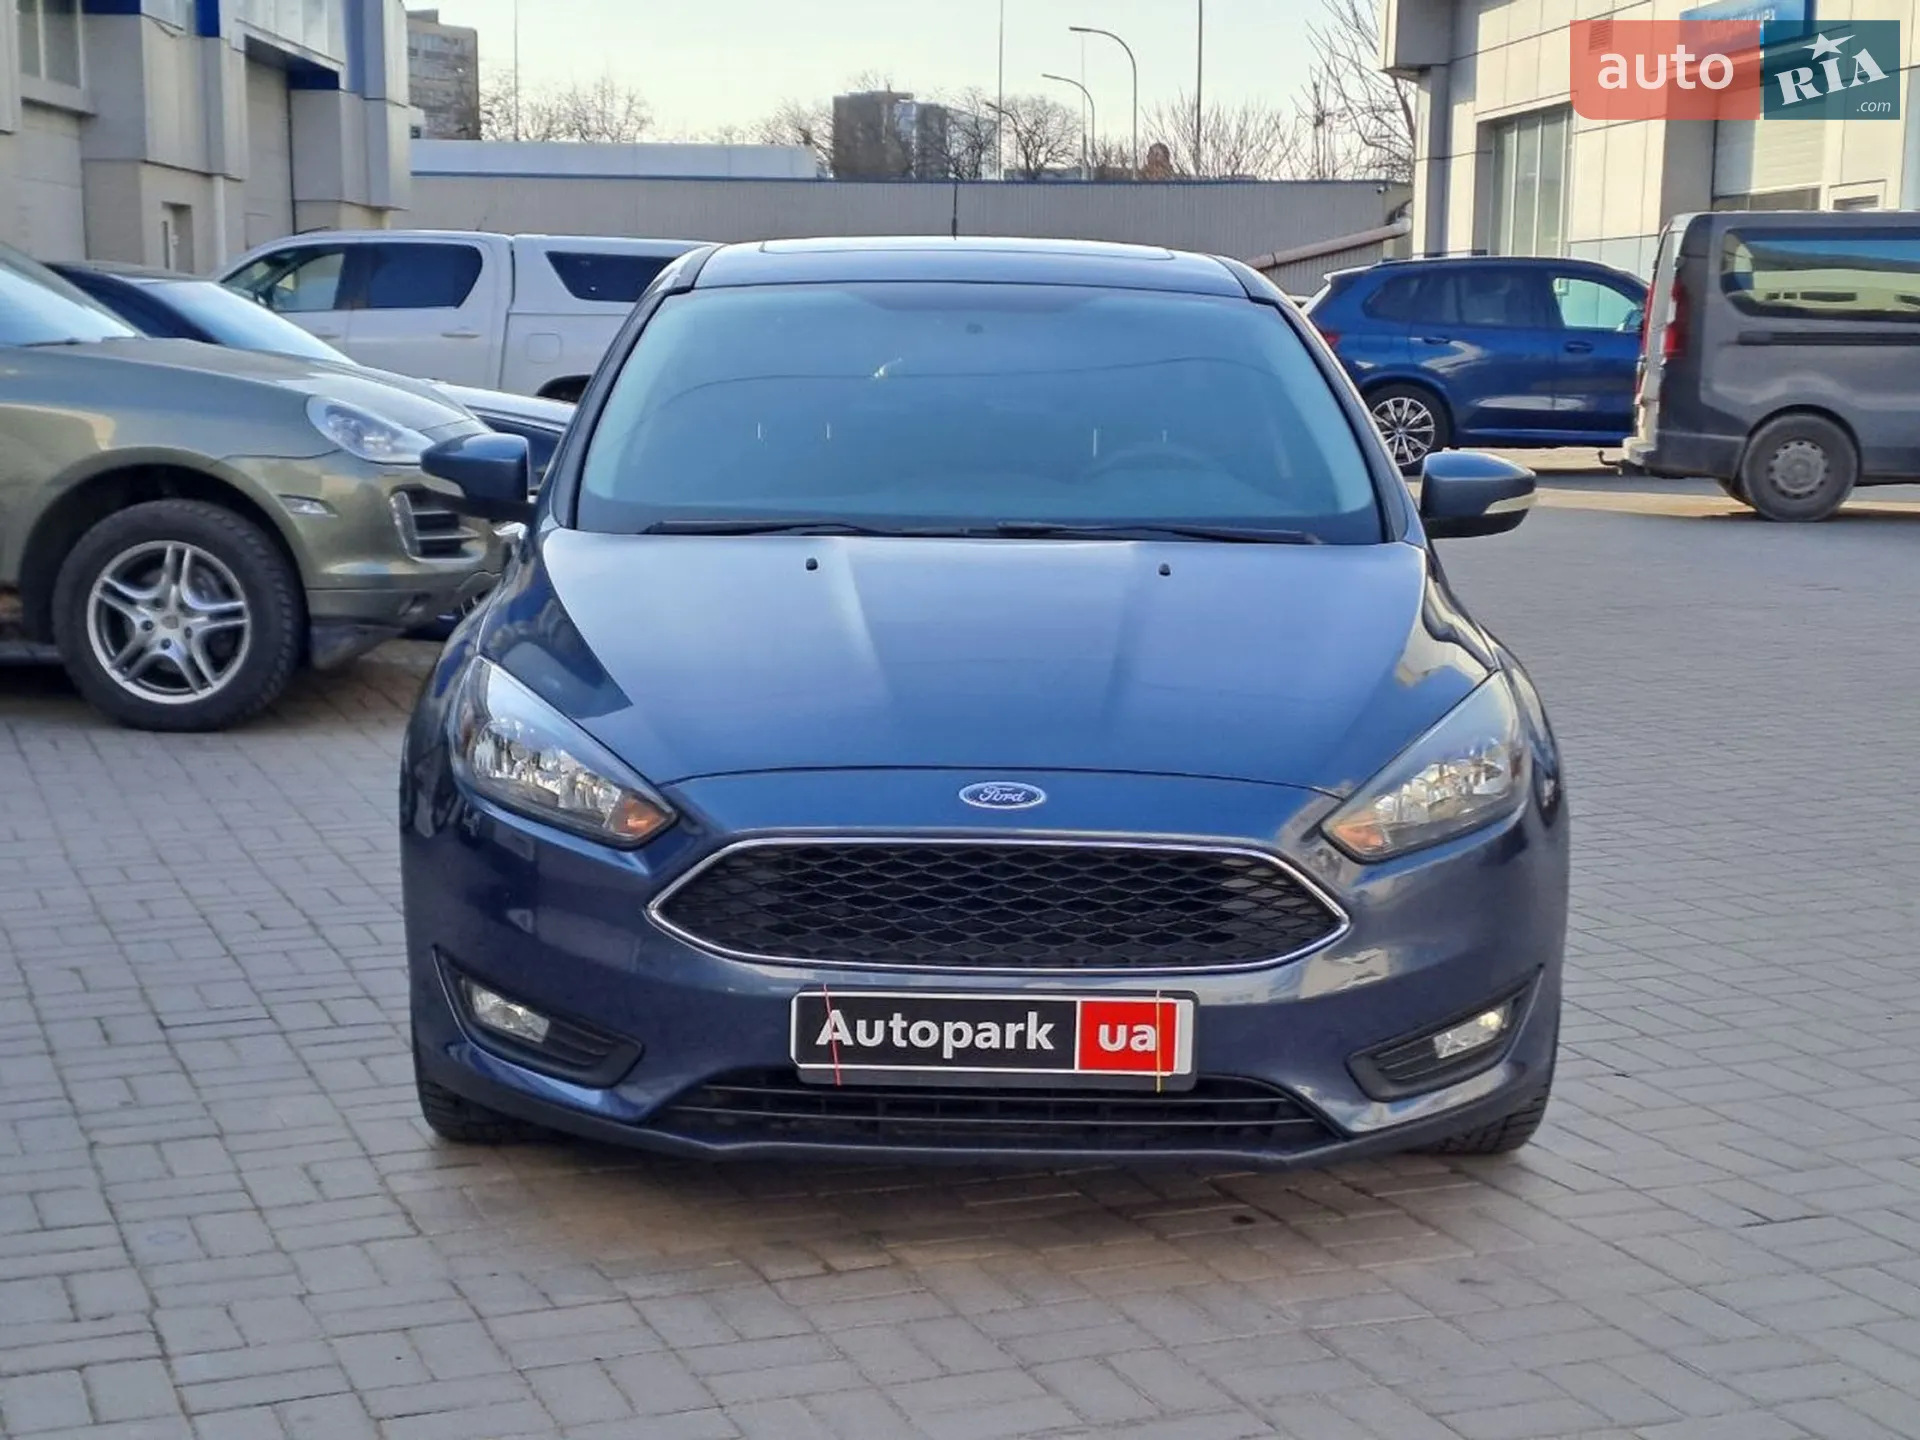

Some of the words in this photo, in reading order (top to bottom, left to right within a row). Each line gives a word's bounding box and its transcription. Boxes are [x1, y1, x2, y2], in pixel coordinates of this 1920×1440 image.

[979, 785, 1026, 802] Ford
[815, 1009, 1055, 1059] Autopark
[1098, 1024, 1157, 1052] ua
